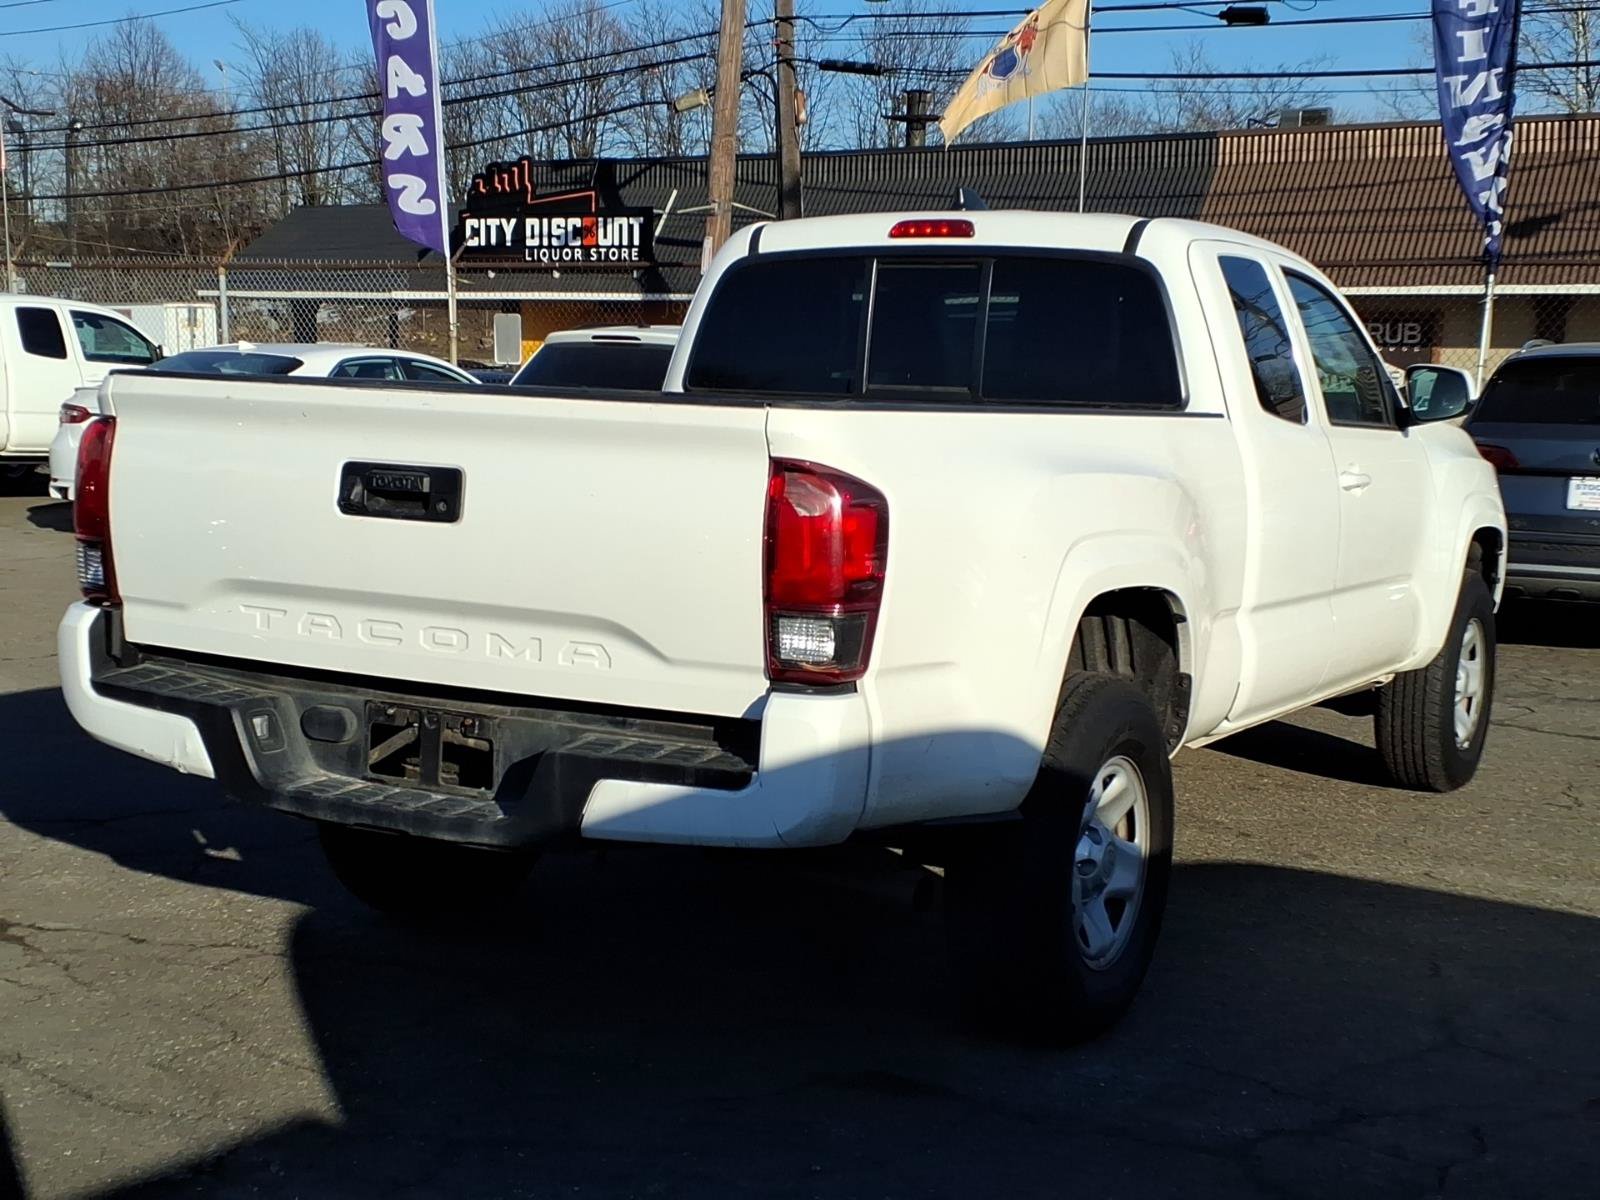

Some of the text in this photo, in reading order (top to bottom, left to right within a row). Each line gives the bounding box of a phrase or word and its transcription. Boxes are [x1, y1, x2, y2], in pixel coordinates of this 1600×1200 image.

[465, 217, 517, 246] CITY
[525, 247, 639, 263] LIQUOR STORE
[239, 604, 612, 669] TACOMA
